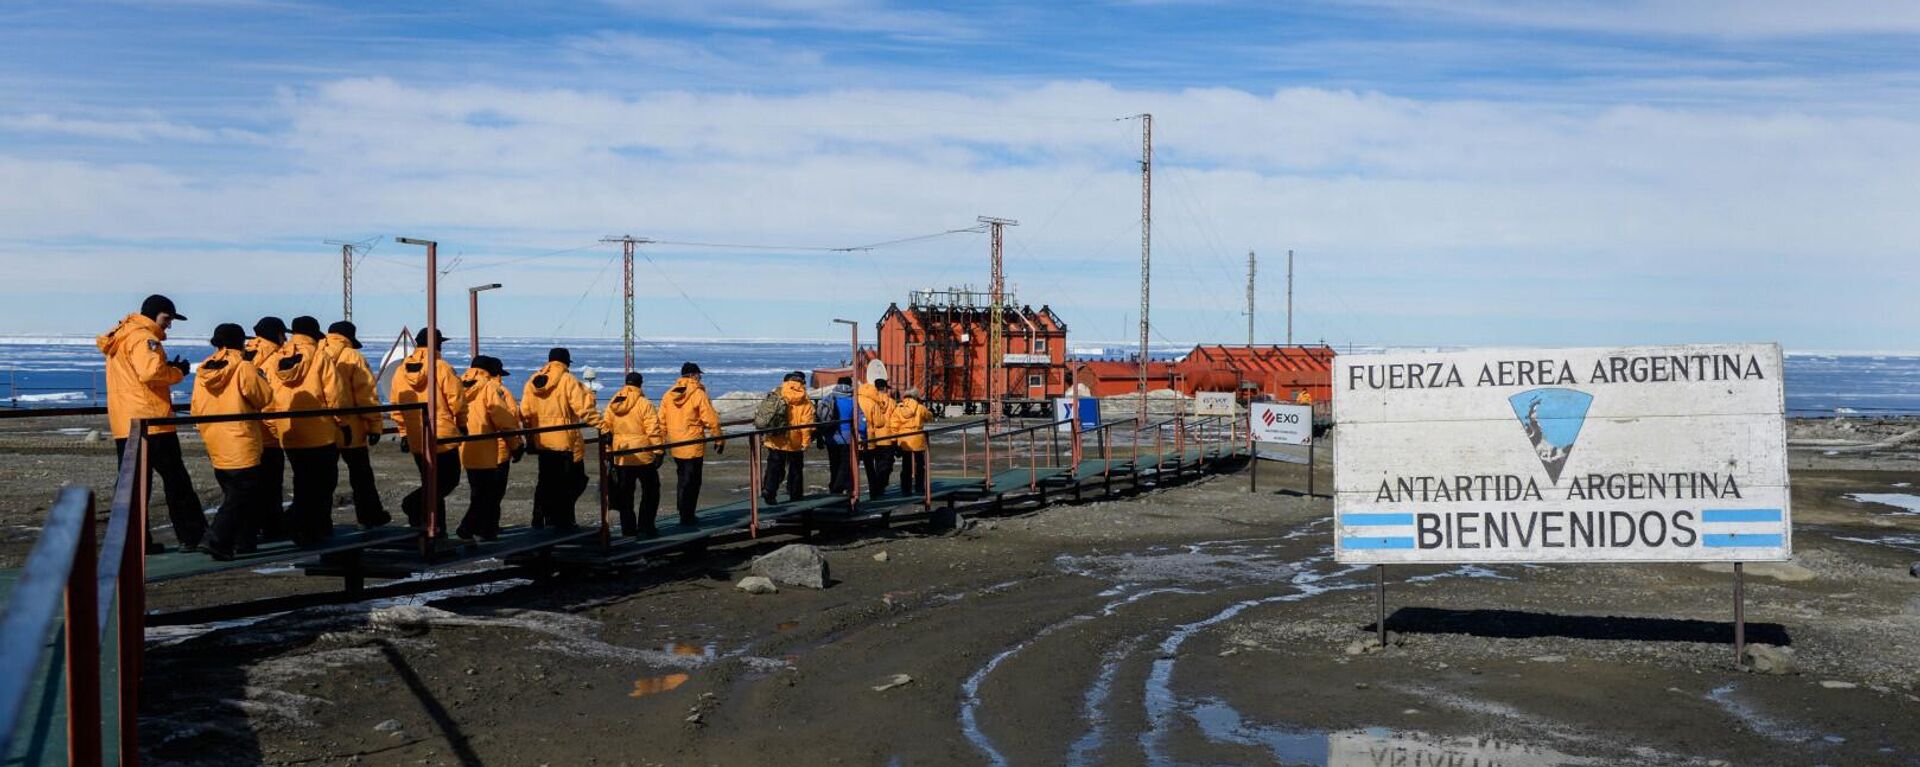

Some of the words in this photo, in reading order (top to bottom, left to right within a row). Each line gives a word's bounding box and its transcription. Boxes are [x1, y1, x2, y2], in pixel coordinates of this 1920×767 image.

[1349, 363, 1464, 390] FUERZA
[1477, 360, 1577, 387] AEREA
[1590, 355, 1764, 384] ARGENTINA
[1275, 413, 1299, 424] EXO
[1567, 472, 1742, 500] ARGENTINA
[1416, 510, 1697, 550] BIENVENIDOS
